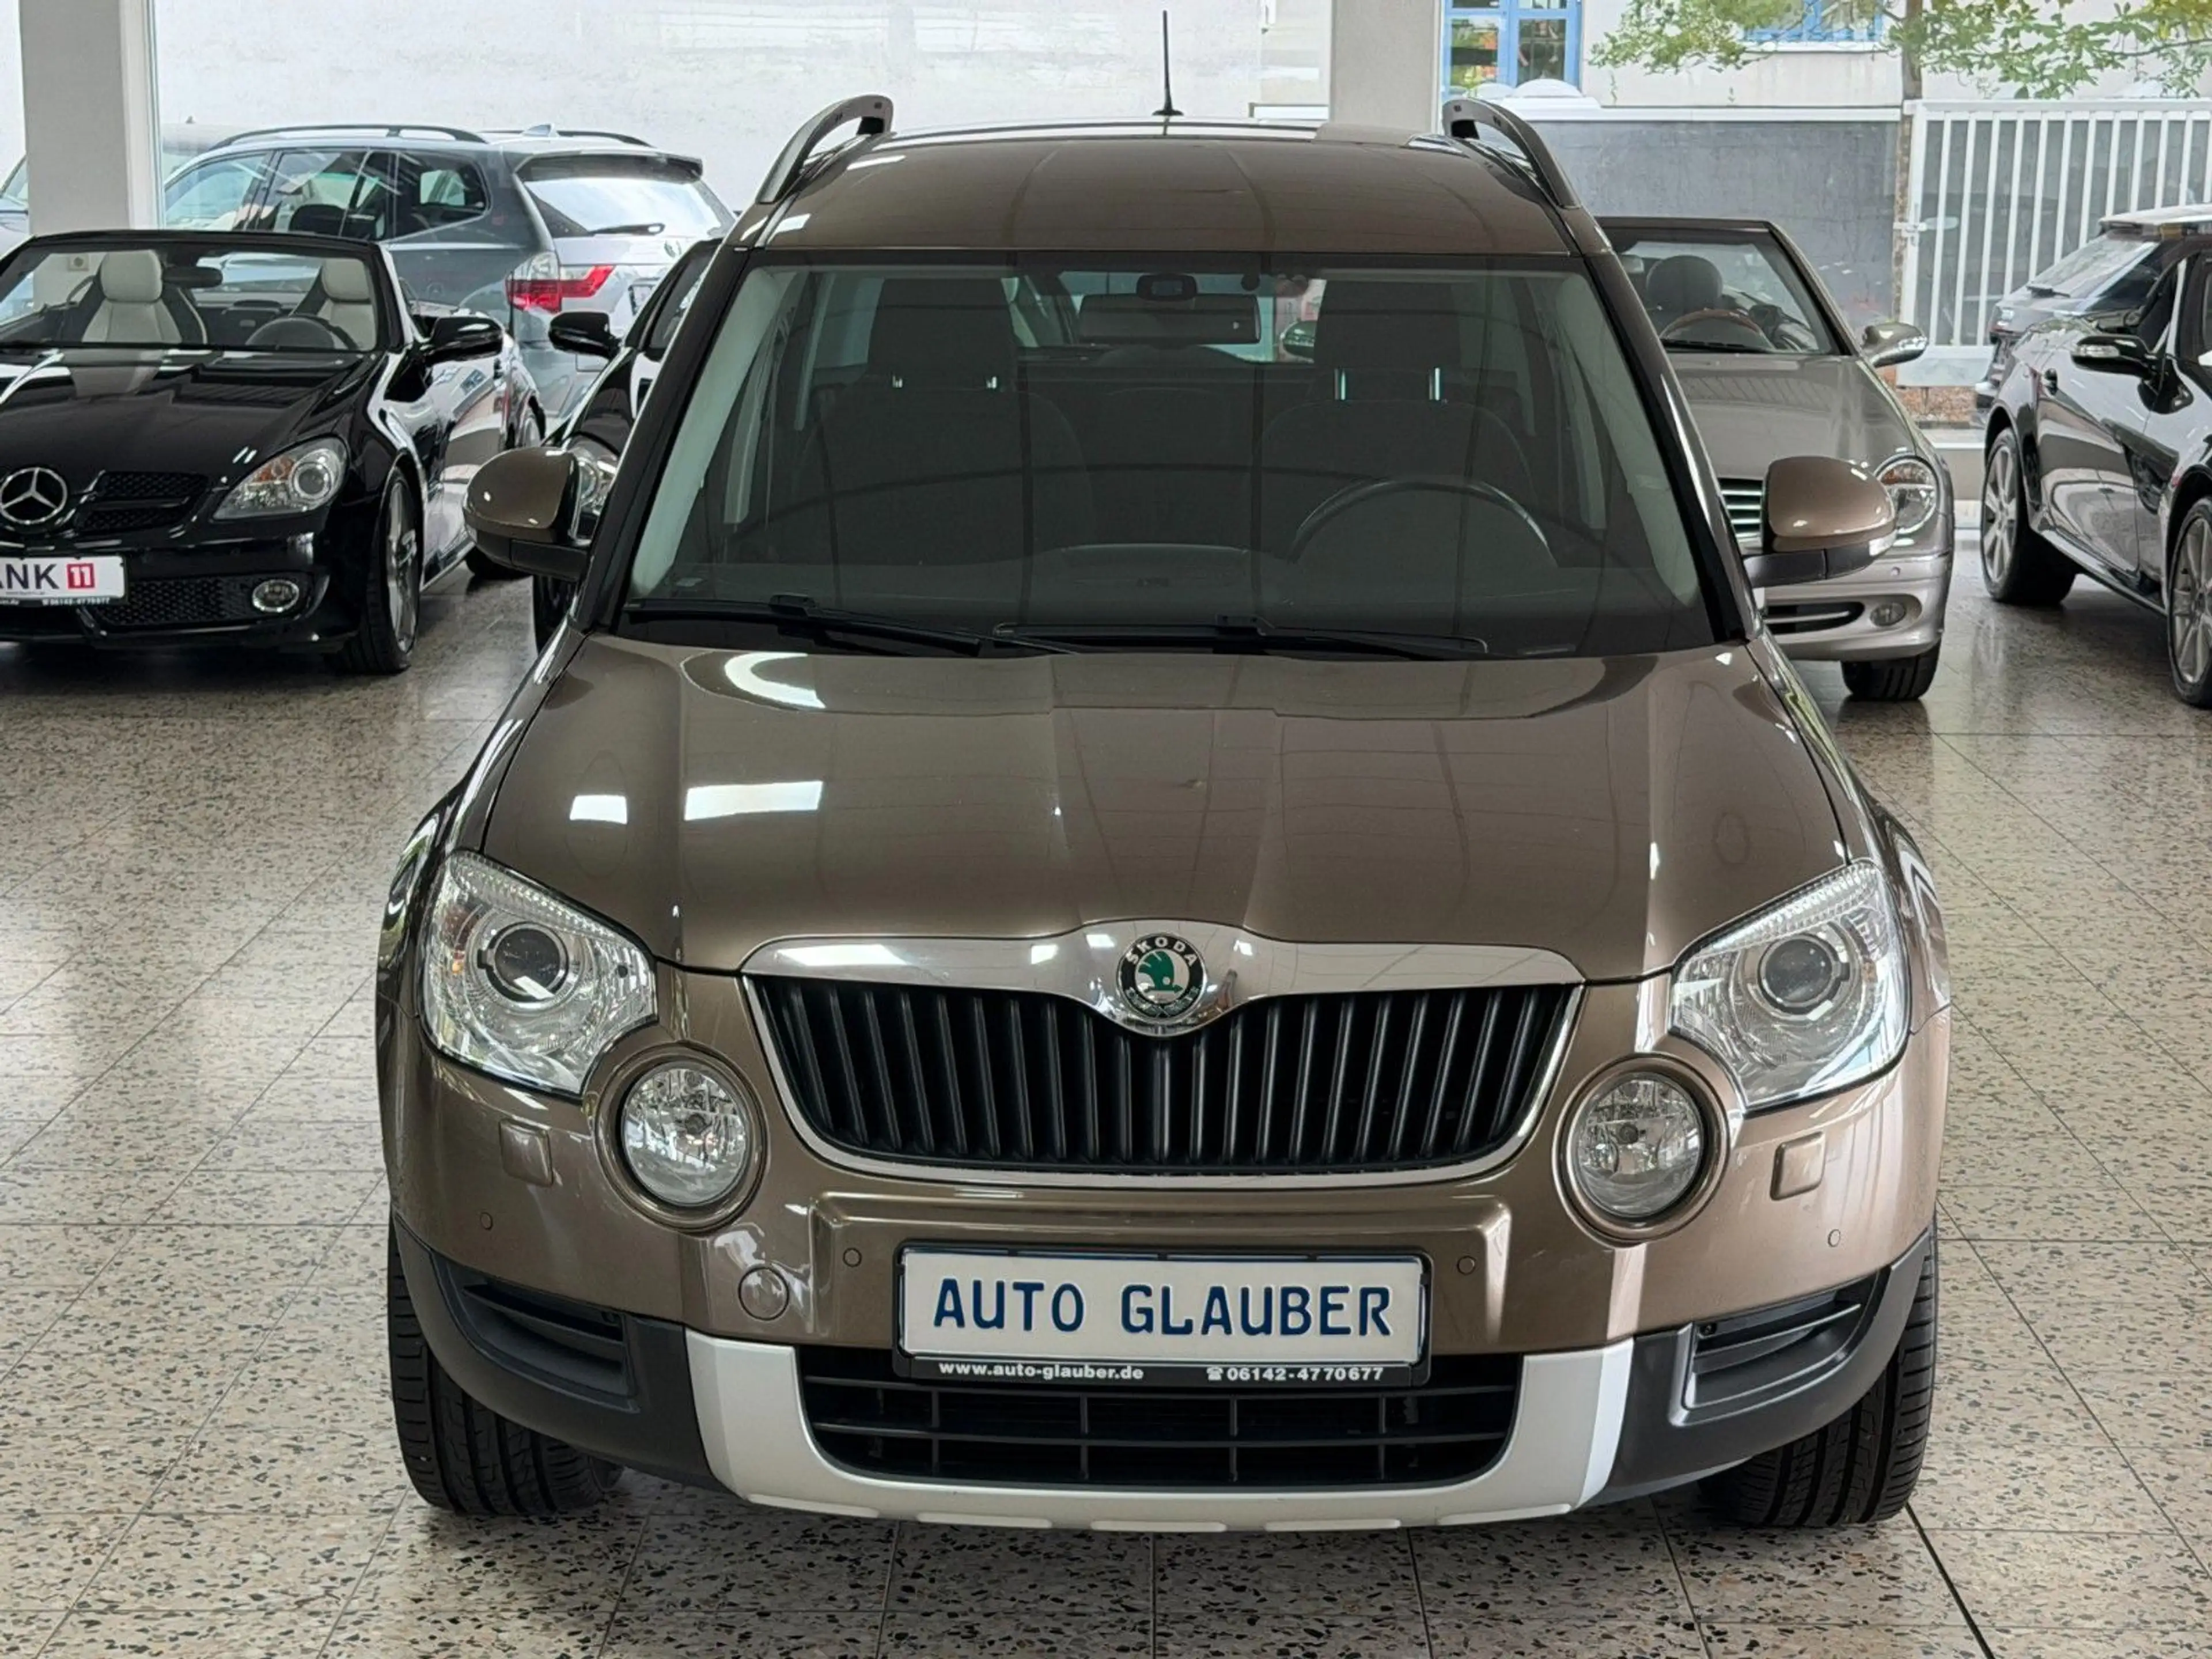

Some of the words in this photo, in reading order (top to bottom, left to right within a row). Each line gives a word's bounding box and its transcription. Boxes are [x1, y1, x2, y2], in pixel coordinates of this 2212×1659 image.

[0, 564, 60, 589] NK
[69, 565, 93, 587] 11
[934, 1278, 1084, 1332] AUTO
[1121, 1285, 1391, 1336] GLAUBER
[938, 1363, 1144, 1380] www.auto-glauber.de
[1227, 1367, 1384, 1382] 06142-4770677
